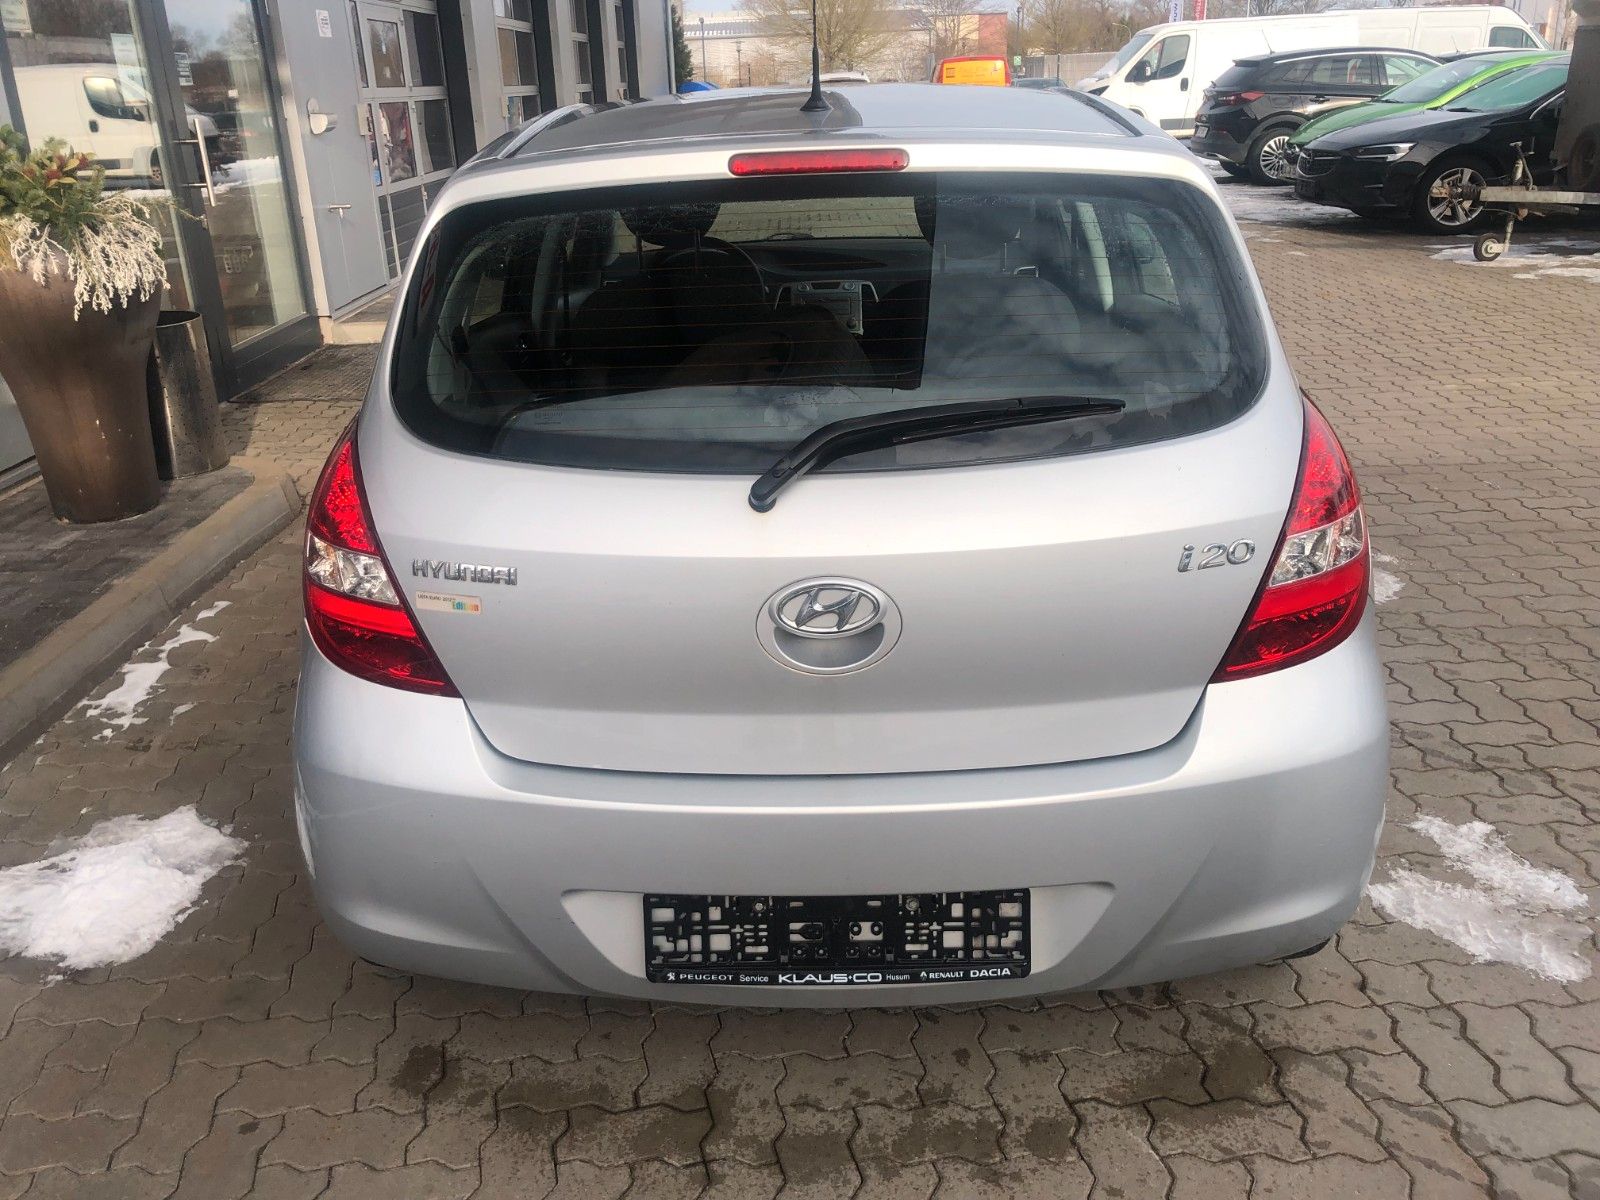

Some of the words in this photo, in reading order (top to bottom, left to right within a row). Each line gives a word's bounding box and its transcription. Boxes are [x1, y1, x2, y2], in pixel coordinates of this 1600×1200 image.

[412, 559, 518, 586] HYUNDAI
[679, 973, 734, 982] PEUGEOT
[739, 974, 769, 983] Service
[886, 973, 911, 981] Husum
[929, 971, 965, 979] RENAULT
[969, 967, 1011, 978] DACIA
